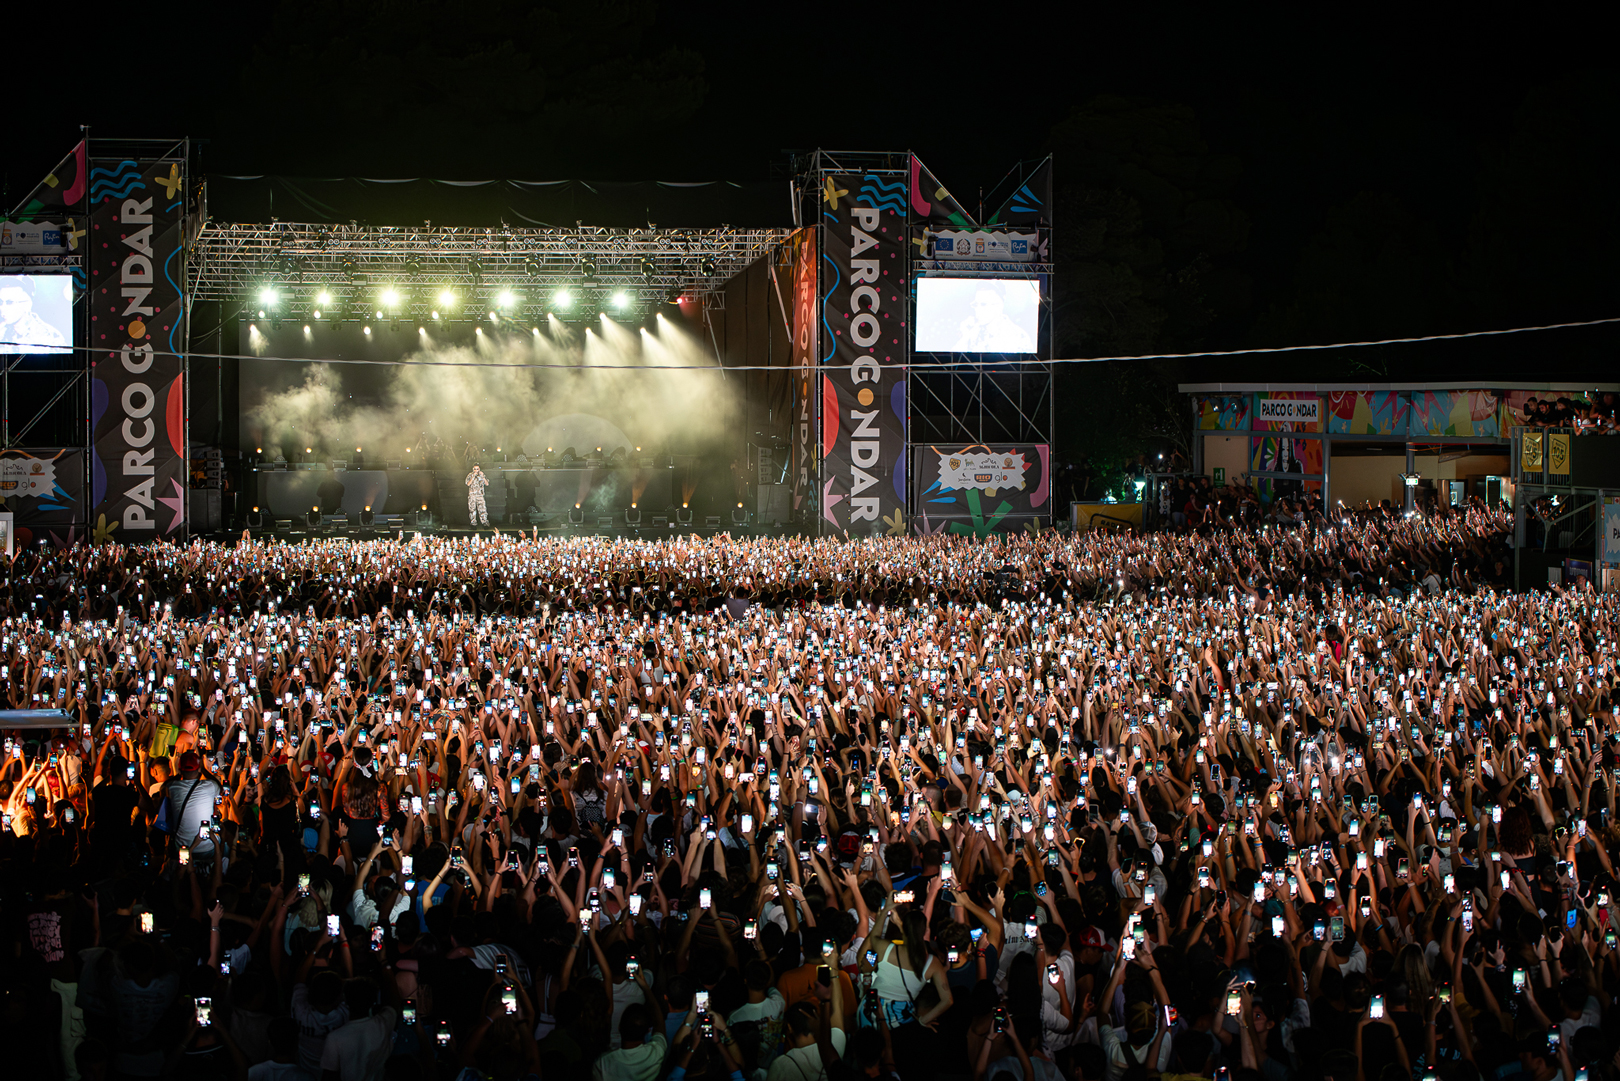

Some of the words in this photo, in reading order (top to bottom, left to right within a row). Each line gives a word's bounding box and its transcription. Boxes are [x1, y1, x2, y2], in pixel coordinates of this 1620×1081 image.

[799, 241, 809, 351] PARCO
[850, 207, 881, 348] PARCO
[122, 382, 155, 530] PARCO
[1261, 403, 1286, 417] PARCO
